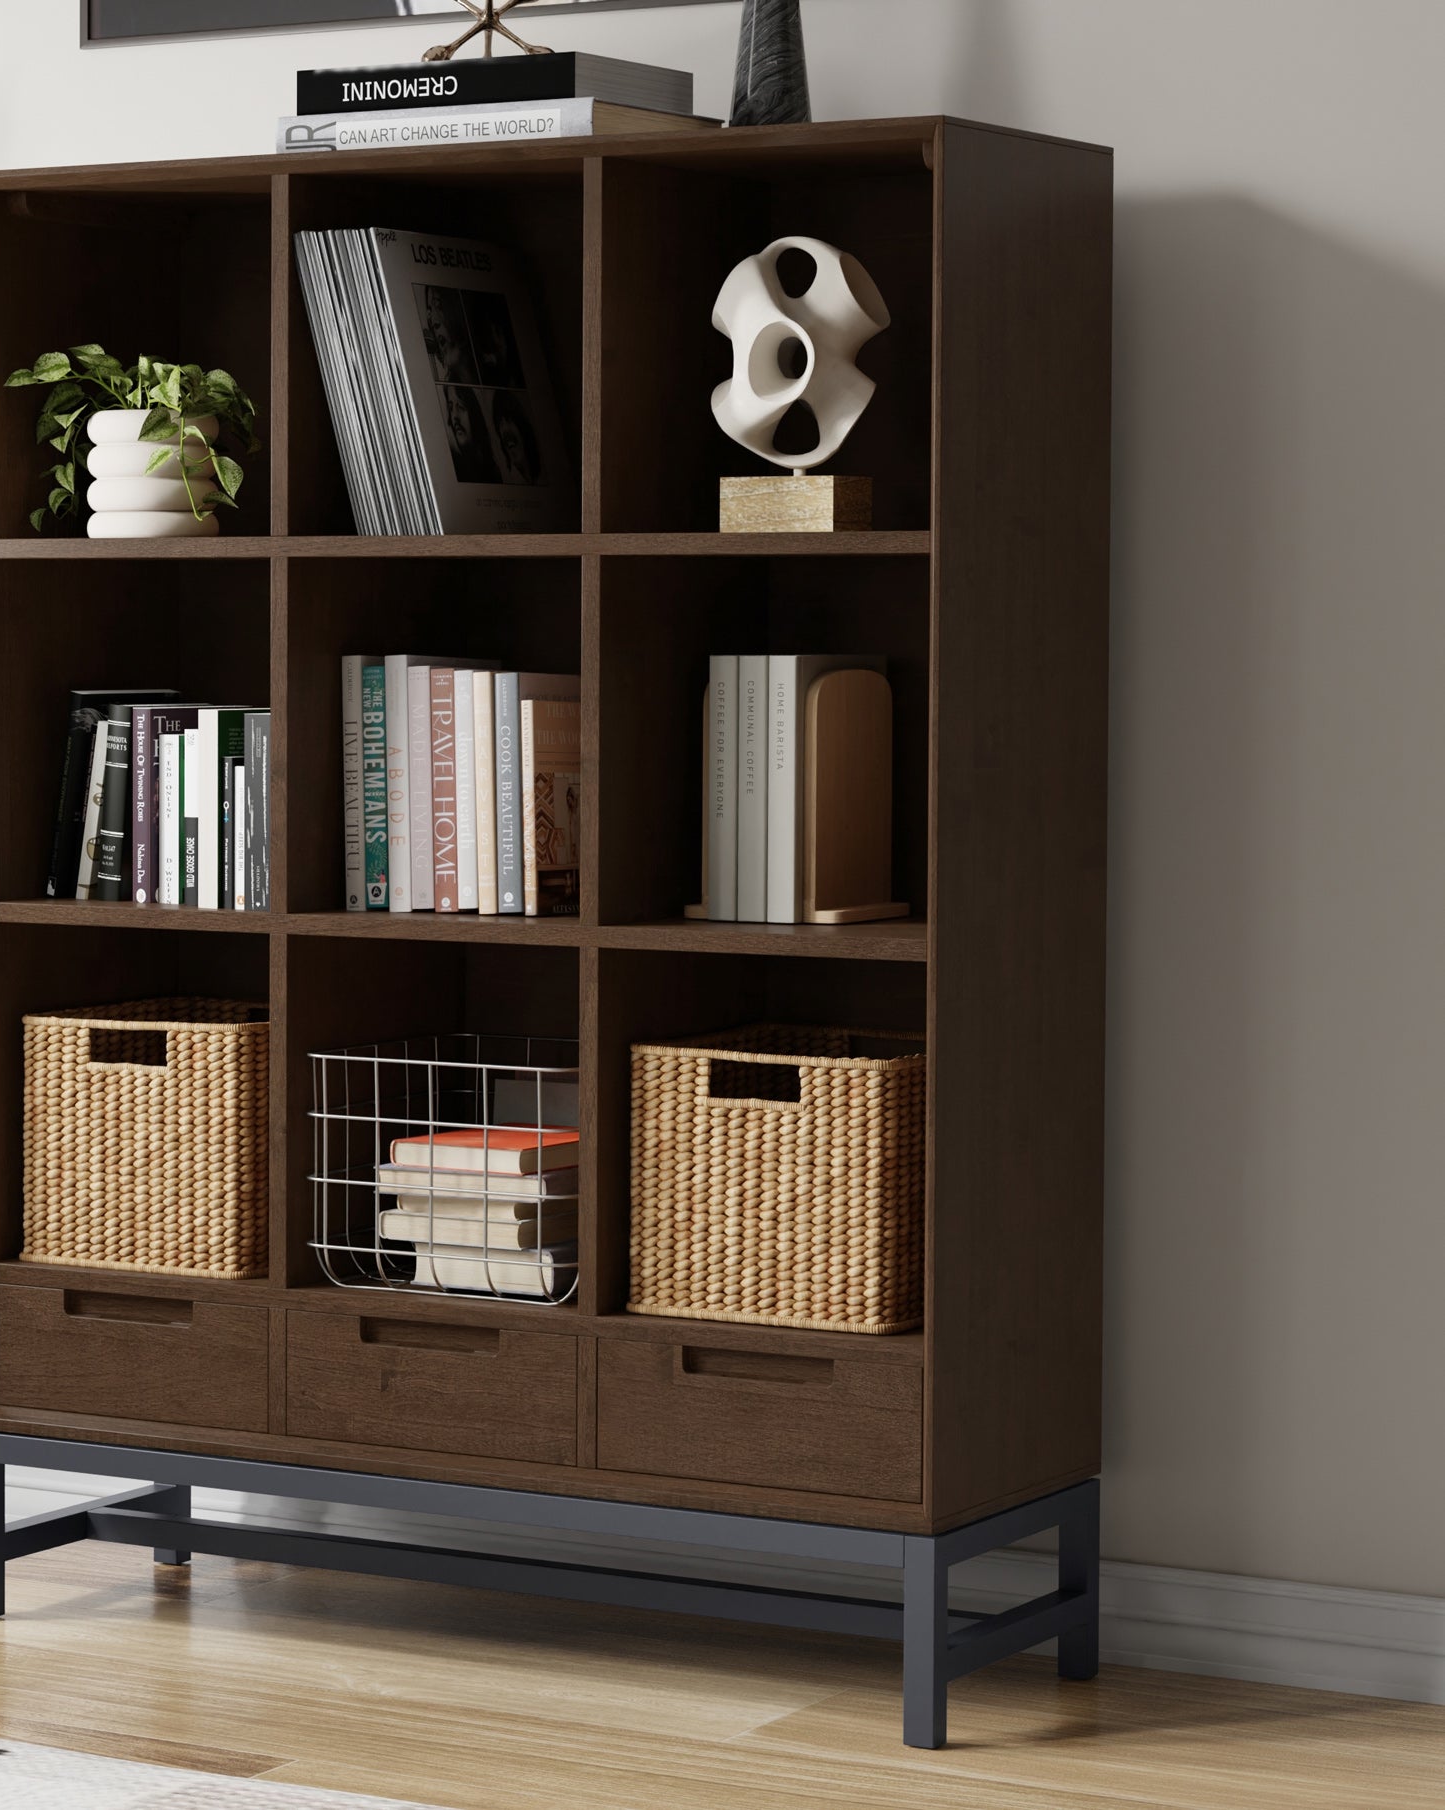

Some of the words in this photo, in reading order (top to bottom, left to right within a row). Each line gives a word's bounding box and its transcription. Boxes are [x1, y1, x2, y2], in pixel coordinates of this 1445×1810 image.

[341, 76, 459, 103] CREMONINI
[339, 129, 367, 145] CAN
[370, 127, 397, 143] ART
[400, 124, 458, 141] CHANGE
[463, 121, 490, 137] THE
[494, 118, 554, 136] WORLD?
[410, 243, 437, 265] LOS
[438, 246, 491, 272] BEATLES
[363, 687, 372, 708] NEW
[372, 689, 383, 708] THE
[716, 681, 725, 725] COFFEE
[746, 680, 755, 744] COMMUNAL
[776, 683, 785, 715] HOME
[137, 714, 145, 729] THE
[153, 715, 181, 734] THE
[345, 720, 358, 763] LIVE
[412, 704, 426, 767] MADE
[433, 692, 454, 789] TRAVEL
[716, 732, 725, 753] FOR
[500, 725, 512, 774] COOK
[776, 721, 784, 770] BARISTA
[716, 759, 724, 818] EVERYONE
[746, 750, 754, 795] COFFEE
[389, 746, 406, 847] ABODE
[345, 770, 360, 877] BEAUTIFUL
[413, 791, 428, 868] LIVING
[434, 797, 456, 884] HOME
[501, 781, 514, 875] BEAUTIFUL
[186, 837, 195, 854] CHASE
[186, 855, 195, 873] GOOSE
[186, 873, 195, 888] WILD
